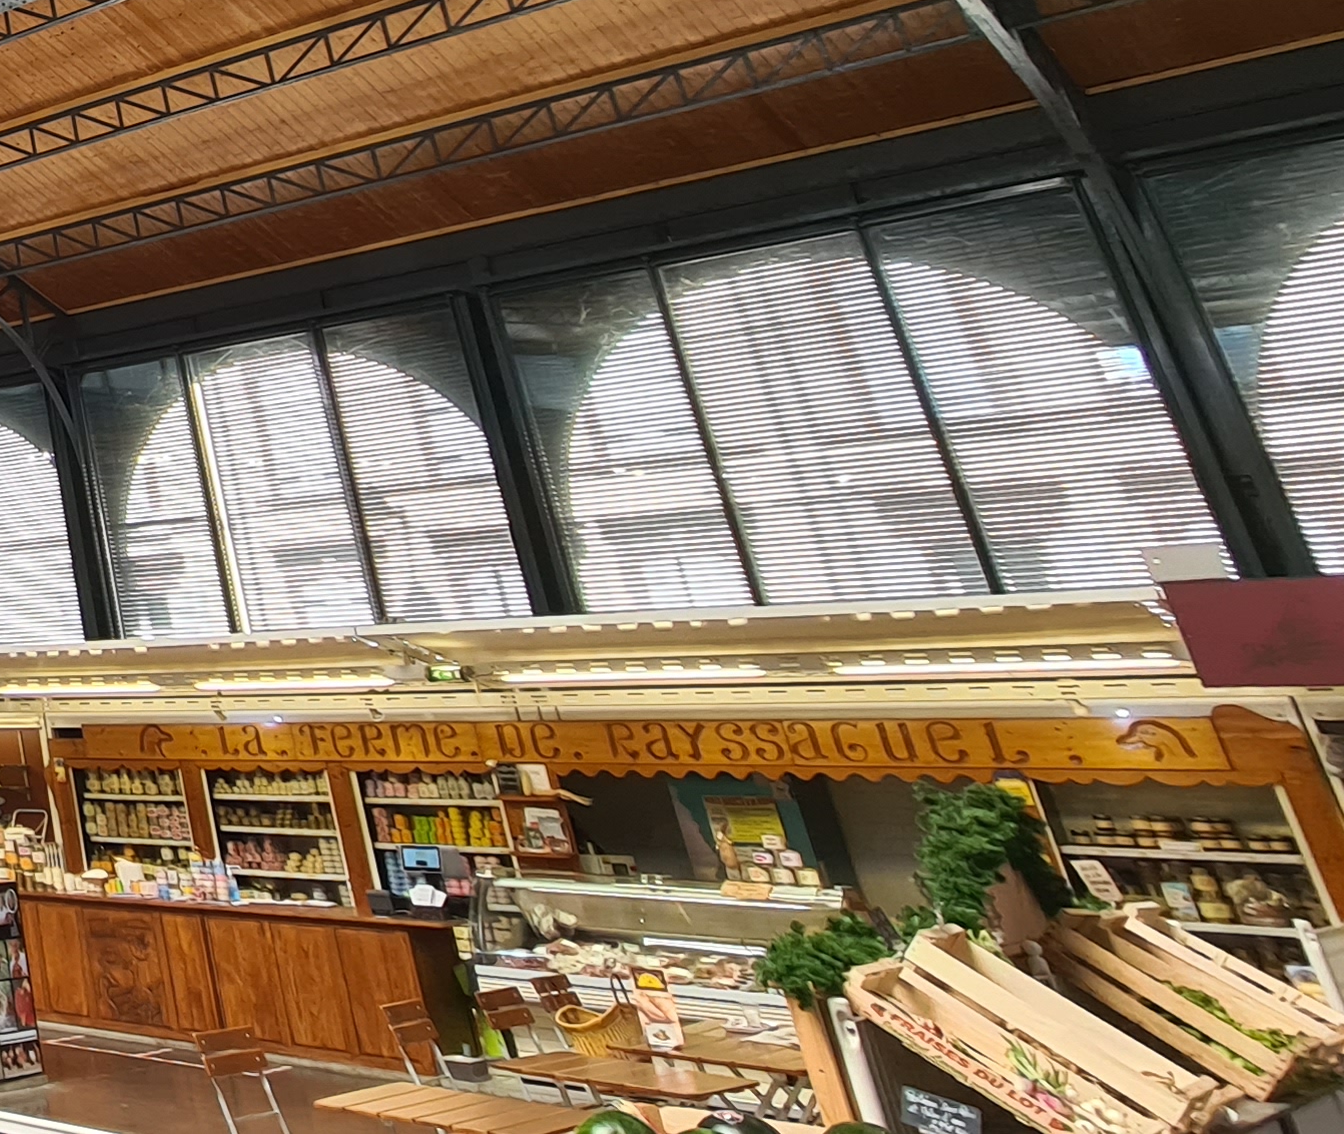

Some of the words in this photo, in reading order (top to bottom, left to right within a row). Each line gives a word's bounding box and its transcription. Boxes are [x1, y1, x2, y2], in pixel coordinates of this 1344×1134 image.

[889, 1012, 971, 1069] FRAISES
[972, 1068, 1004, 1089] DU
[1006, 1089, 1047, 1116] LOT
